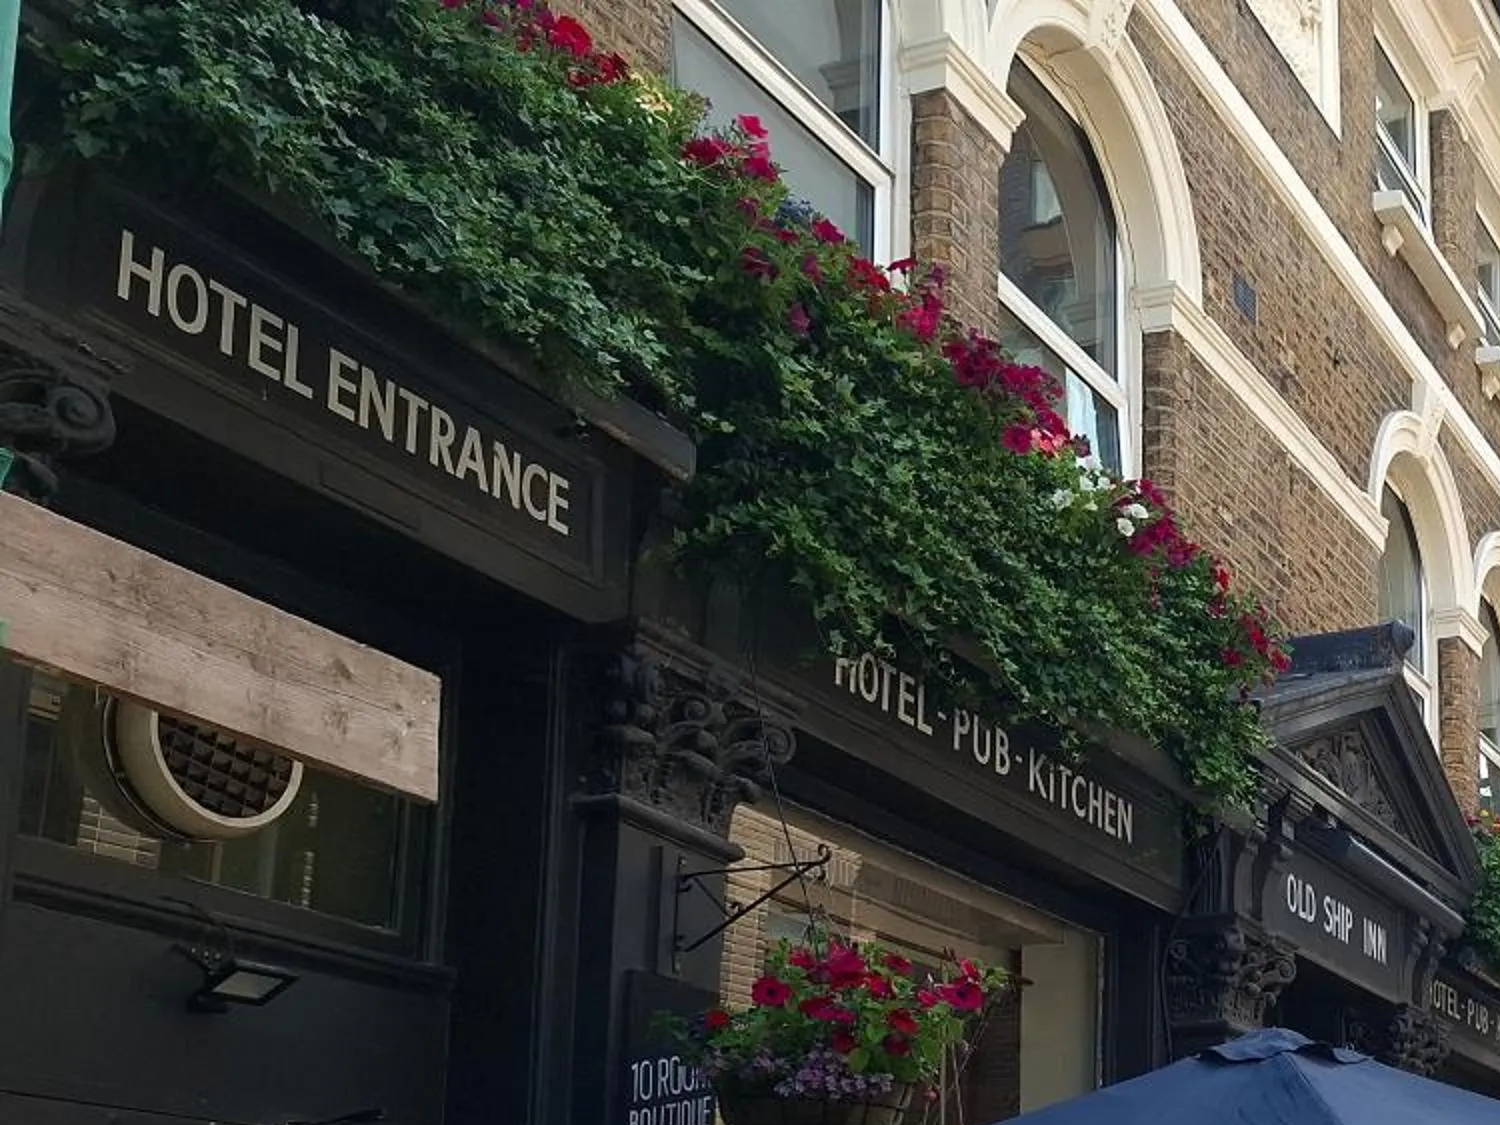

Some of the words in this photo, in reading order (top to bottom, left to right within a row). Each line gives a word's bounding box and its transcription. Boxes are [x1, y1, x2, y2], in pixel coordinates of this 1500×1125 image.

[117, 230, 314, 398] HOTEL
[327, 347, 571, 536] ENTRANCE
[953, 708, 1011, 777] PUB
[1286, 873, 1317, 922] OLD
[1322, 895, 1354, 945] SHIP
[1362, 918, 1388, 966] INN
[1466, 998, 1490, 1036] PUB
[631, 1059, 653, 1103] 10
